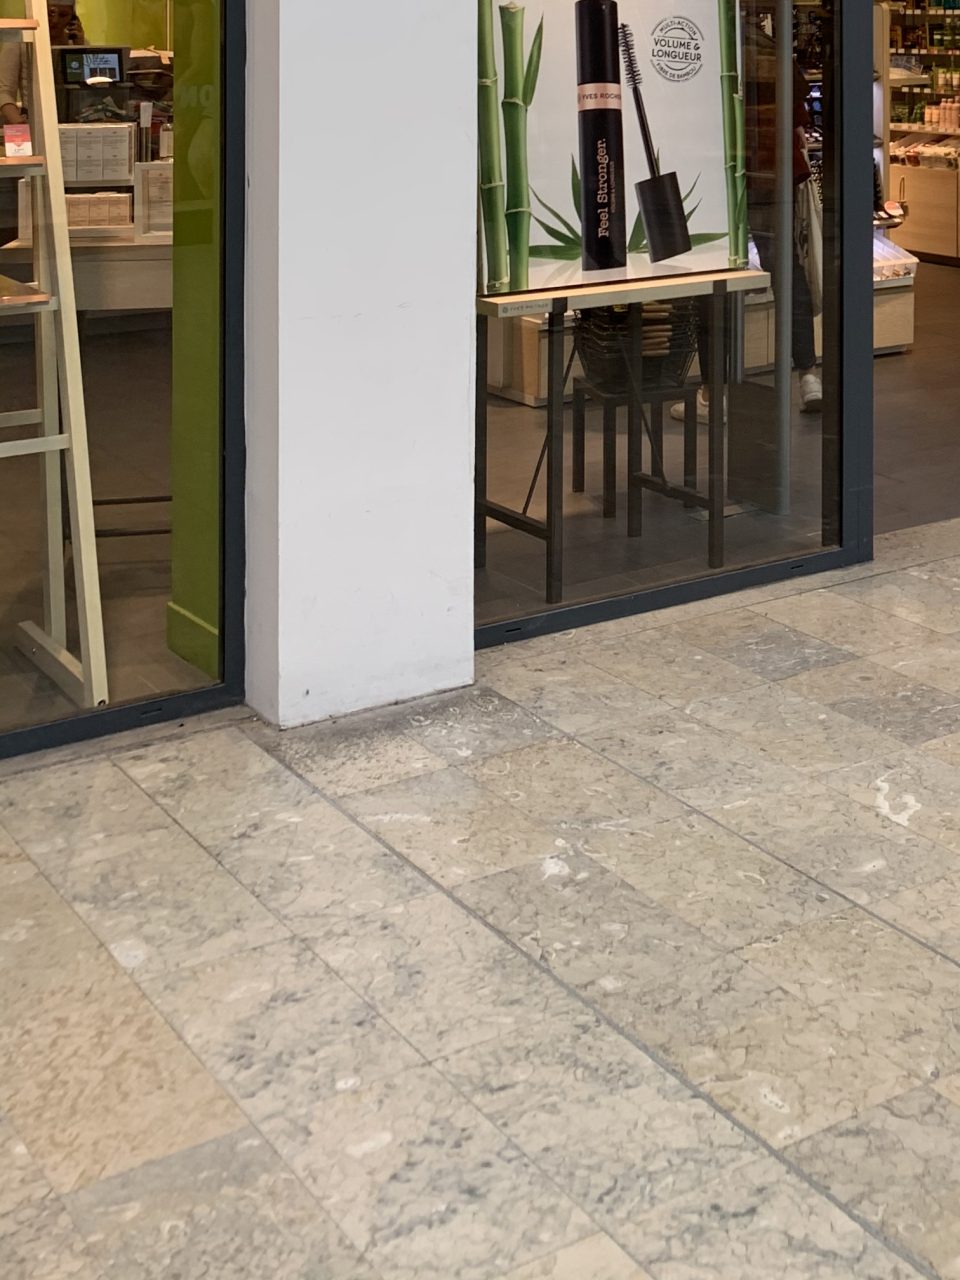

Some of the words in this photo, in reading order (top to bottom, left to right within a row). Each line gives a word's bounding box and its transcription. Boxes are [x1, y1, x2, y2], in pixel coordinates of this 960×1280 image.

[659, 20, 698, 36] MULTI-ACTION
[653, 37, 692, 50] VOLUME
[693, 42, 701, 51] &
[651, 48, 702, 61] LONGUEUR
[582, 92, 598, 100] YVES
[597, 138, 609, 204] Stronger.
[597, 209, 609, 239] Feel
